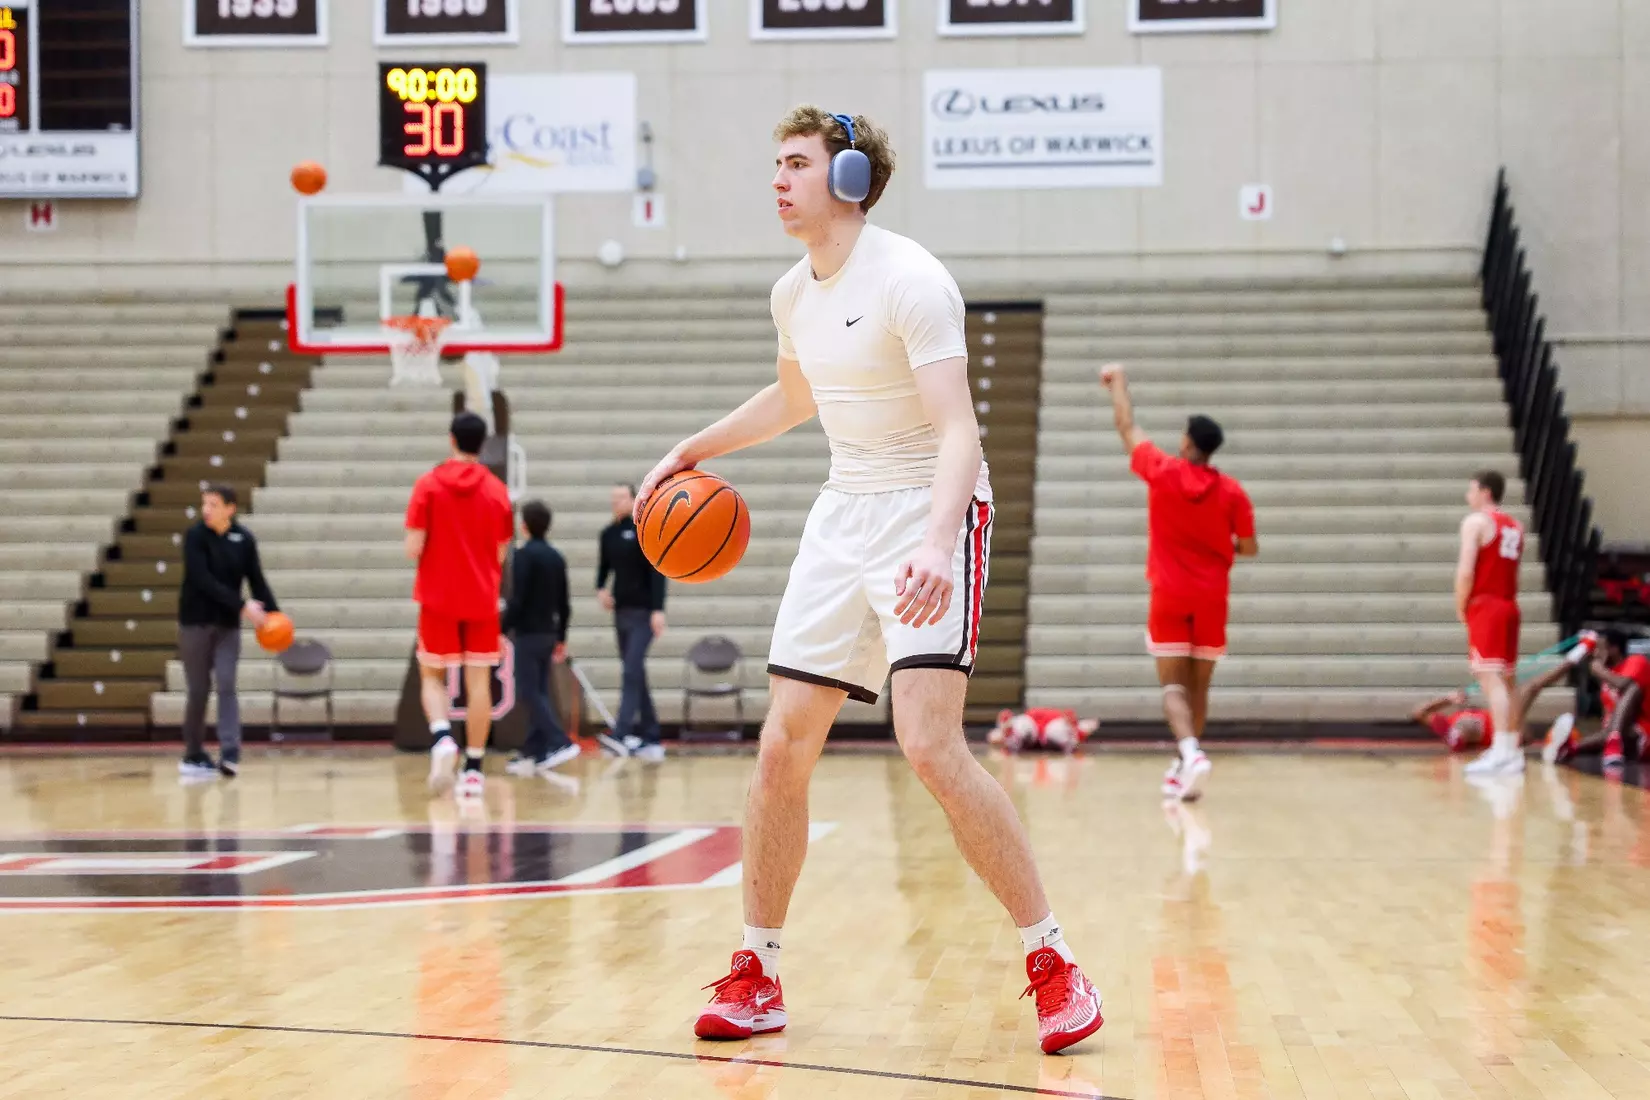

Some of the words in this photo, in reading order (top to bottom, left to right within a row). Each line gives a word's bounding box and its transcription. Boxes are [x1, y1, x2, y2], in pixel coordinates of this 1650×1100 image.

[387, 68, 477, 103] 90:00
[981, 94, 1105, 113] LEXUS
[403, 100, 463, 156] 30
[933, 136, 1000, 156] LEXUS
[1009, 136, 1036, 155] OF
[1043, 134, 1153, 155] WARWICK
[1248, 192, 1266, 214] J
[31, 203, 52, 227] H
